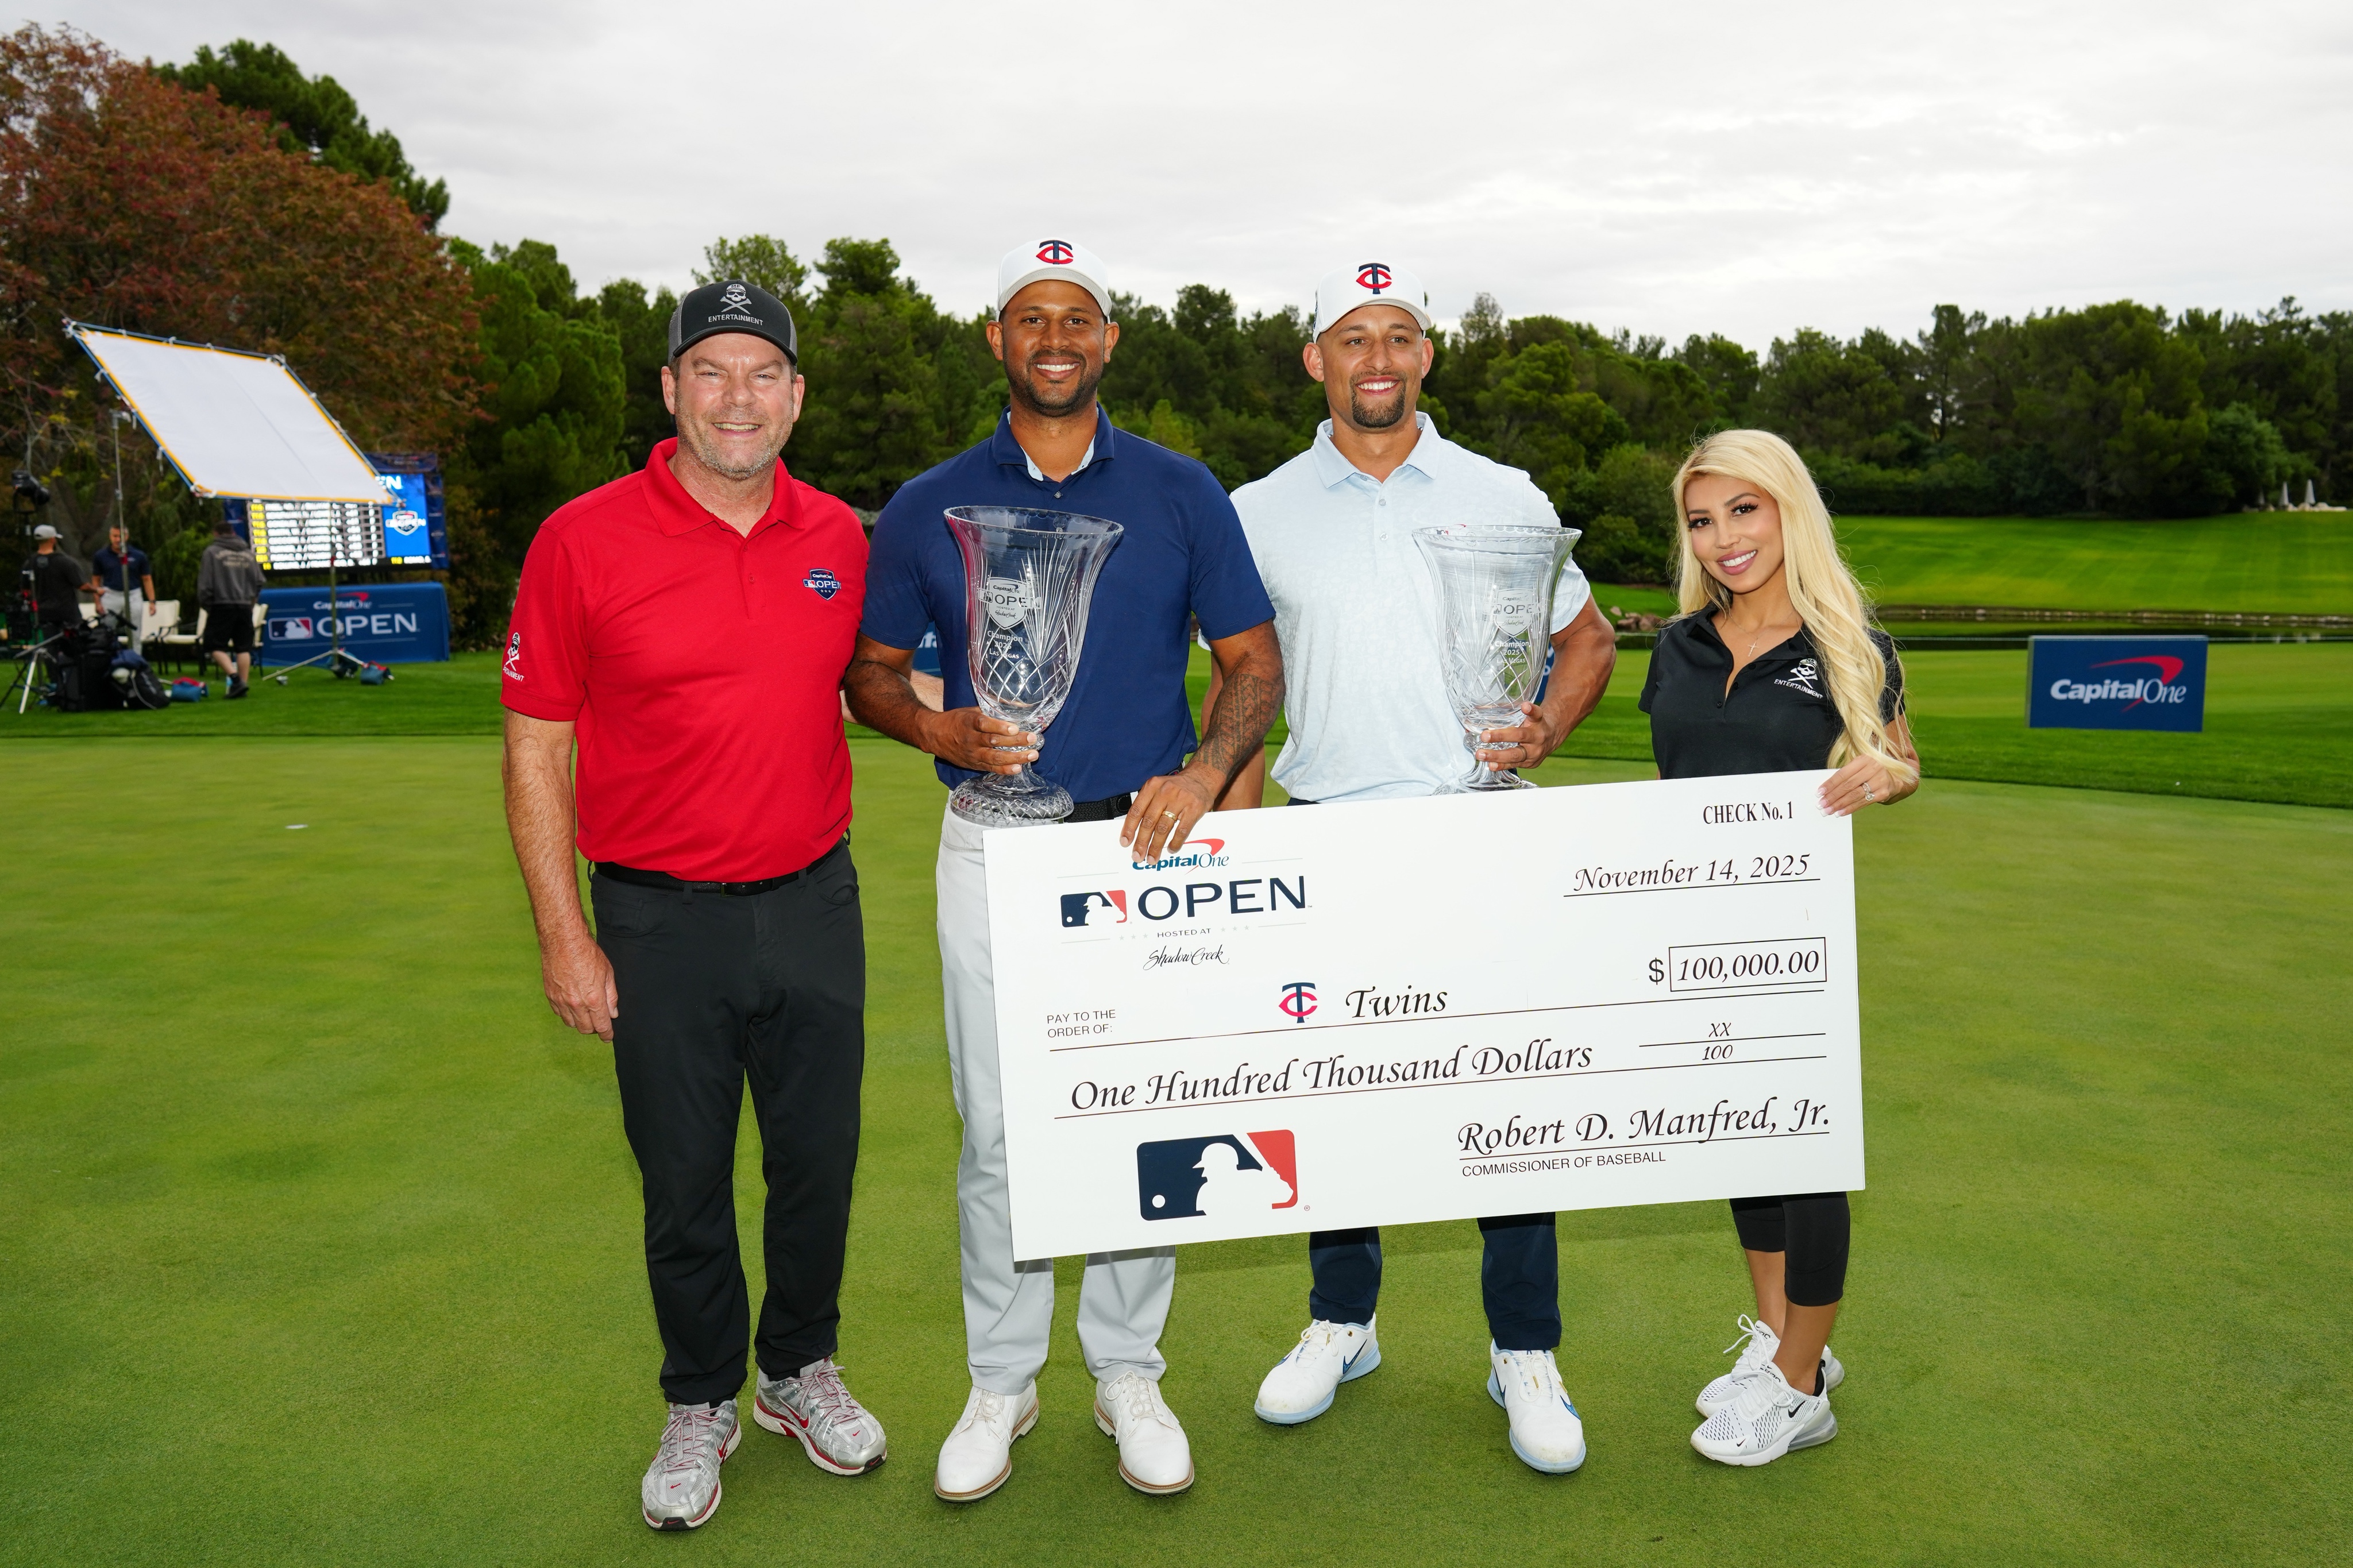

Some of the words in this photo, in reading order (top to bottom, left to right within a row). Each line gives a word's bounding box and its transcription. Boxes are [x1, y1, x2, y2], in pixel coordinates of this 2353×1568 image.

[708, 314, 763, 326] ENTERTAINMENT
[816, 580, 842, 590] OPEN
[994, 594, 1040, 609] OPEN
[317, 612, 417, 637] OPEN
[987, 630, 1023, 642] Champion
[1773, 679, 1824, 700] ENTERTAINMENT
[1703, 803, 1758, 825] CHECK
[1761, 802, 1783, 821] No.
[1787, 801, 1793, 820] 1
[1573, 859, 1699, 891] November
[1705, 858, 1739, 884] 14,
[1749, 853, 1811, 879] 2025
[1137, 875, 1306, 921] OPEN
[1157, 929, 1197, 938] HOSTED
[1649, 957, 1665, 986] $
[1677, 949, 1820, 983] 100,000.00
[1345, 984, 1448, 1018] Twins
[1047, 1013, 1070, 1024] PAY
[1073, 1011, 1089, 1021] TO
[1093, 1009, 1116, 1019] THE
[1047, 1026, 1090, 1038] ORDER
[1093, 1024, 1113, 1034] OF:
[1702, 1044, 1734, 1061] 100
[1071, 1081, 1136, 1110] One
[1144, 1058, 1299, 1104] Hundred
[1302, 1044, 1469, 1090] Thousand
[1471, 1037, 1592, 1076] Dollars
[1457, 1115, 1565, 1156] Robert
[1575, 1113, 1614, 1141] D.
[1628, 1095, 1779, 1144] Manfred,
[1788, 1098, 1830, 1133] Jr.
[1462, 1158, 1570, 1177] COMMISSIONER
[1573, 1156, 1593, 1168] OF
[1596, 1150, 1667, 1167] BASEBALL
